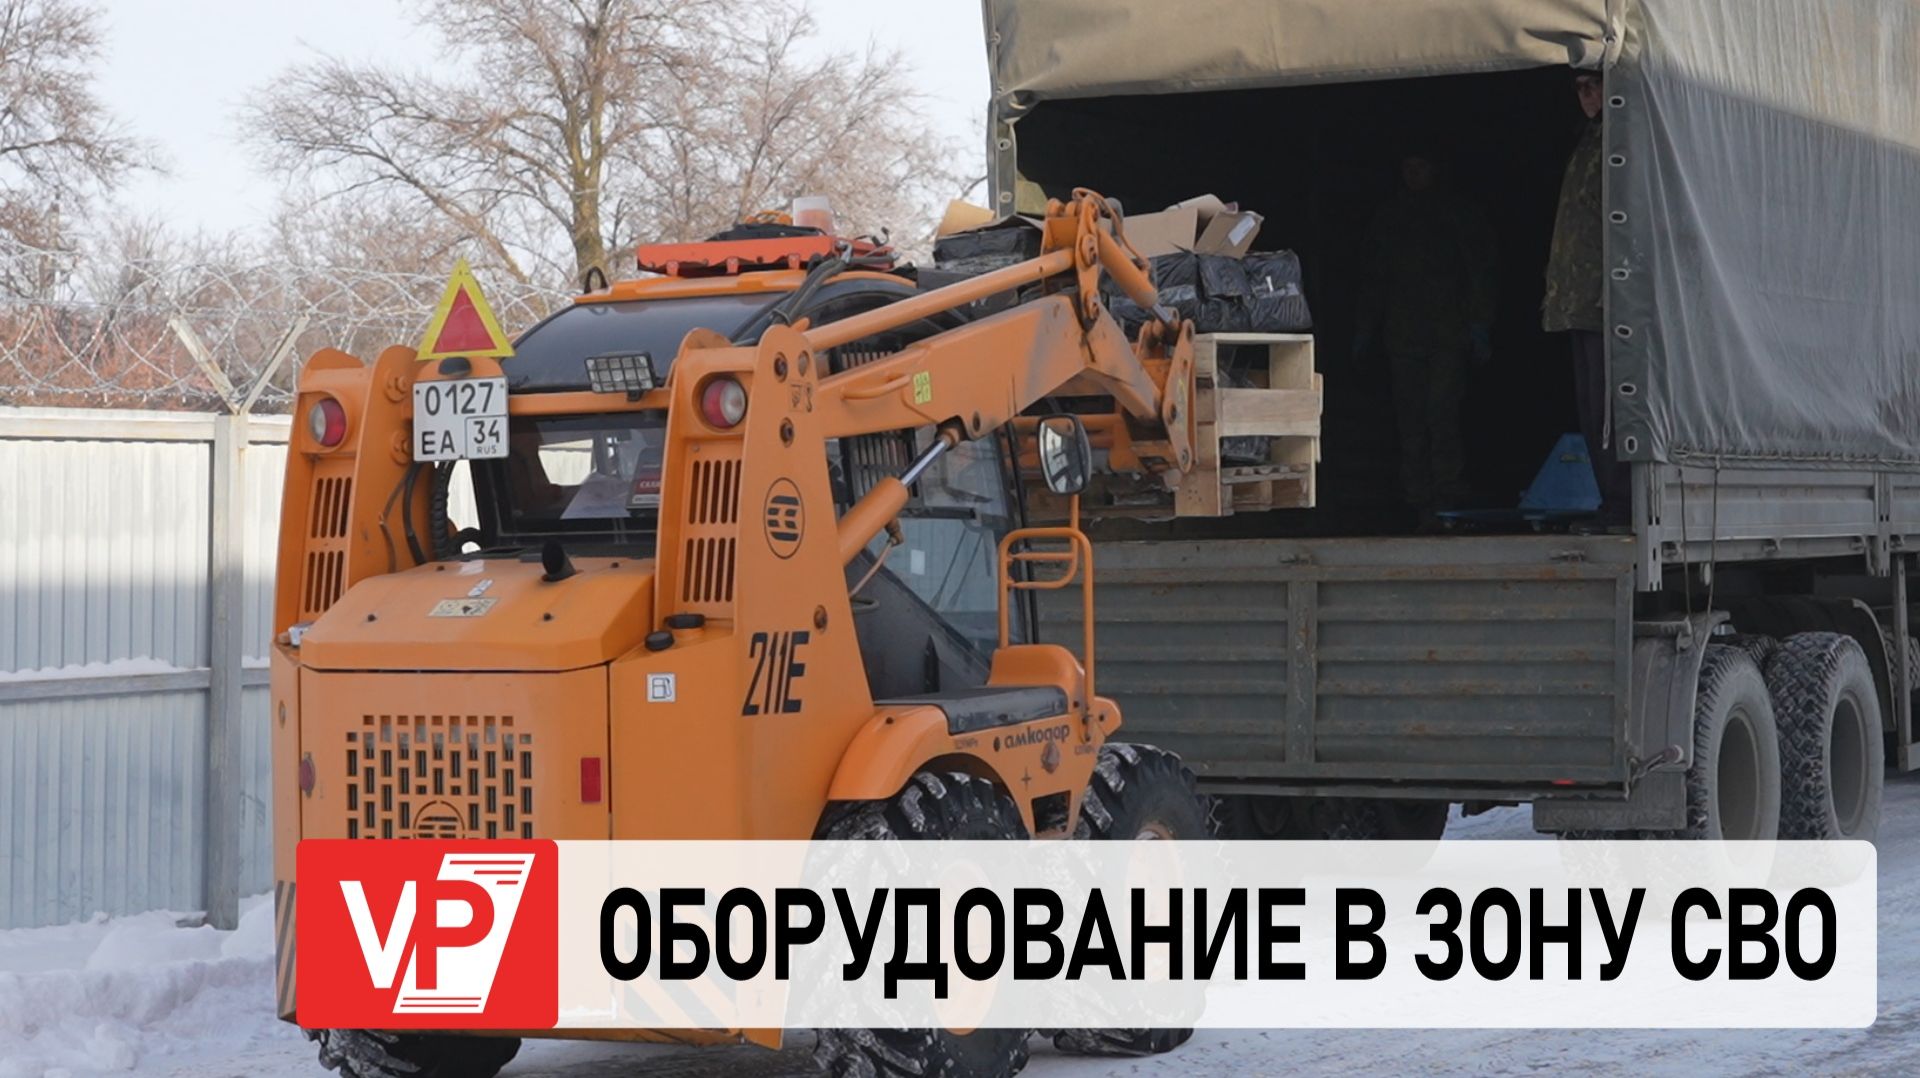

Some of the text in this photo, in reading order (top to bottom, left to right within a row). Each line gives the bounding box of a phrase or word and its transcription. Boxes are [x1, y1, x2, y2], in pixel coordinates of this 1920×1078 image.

[425, 382, 494, 416] 0127
[422, 429, 455, 455] ЕА
[473, 419, 500, 443] 34
[476, 444, 497, 455] RUS
[742, 631, 810, 716] 211E
